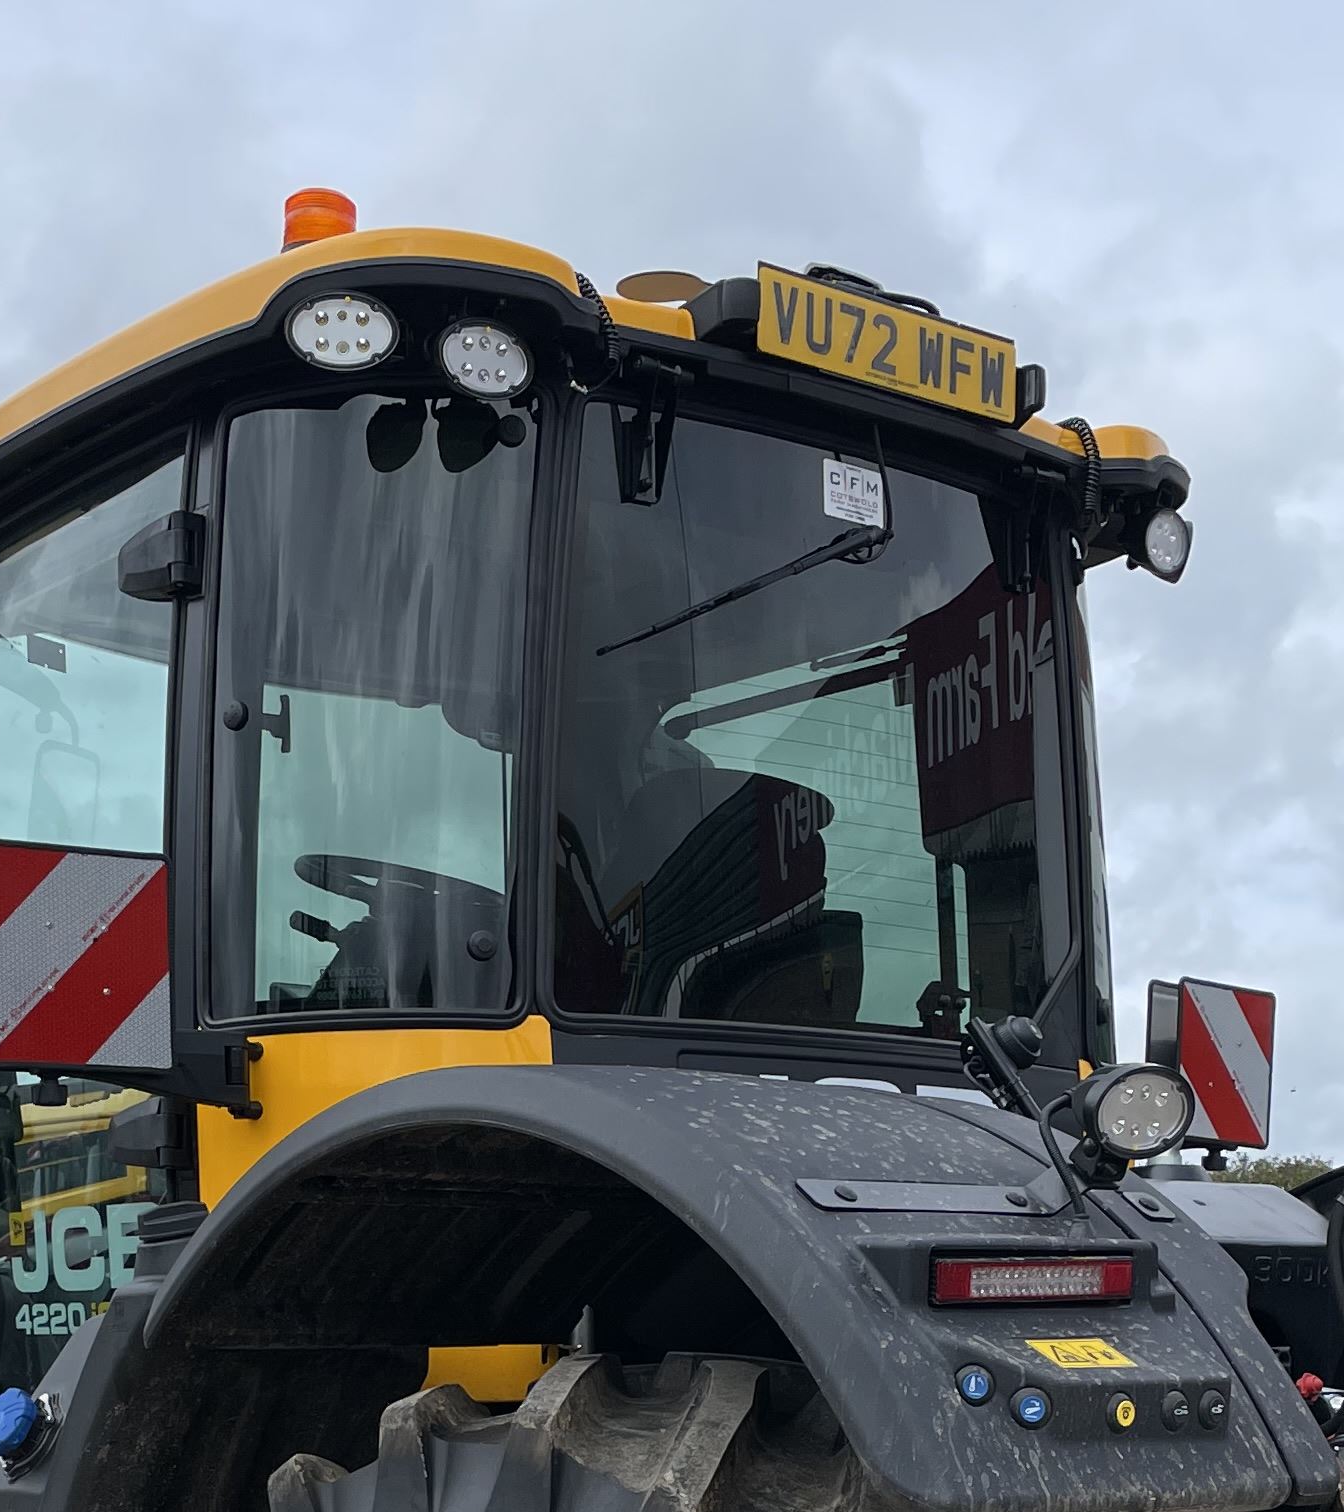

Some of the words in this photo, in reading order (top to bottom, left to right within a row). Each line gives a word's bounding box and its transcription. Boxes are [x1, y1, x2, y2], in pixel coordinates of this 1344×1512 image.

[773, 281, 897, 376] VU72
[919, 326, 1005, 408] WFW
[14, 1302, 91, 1335] 4220
